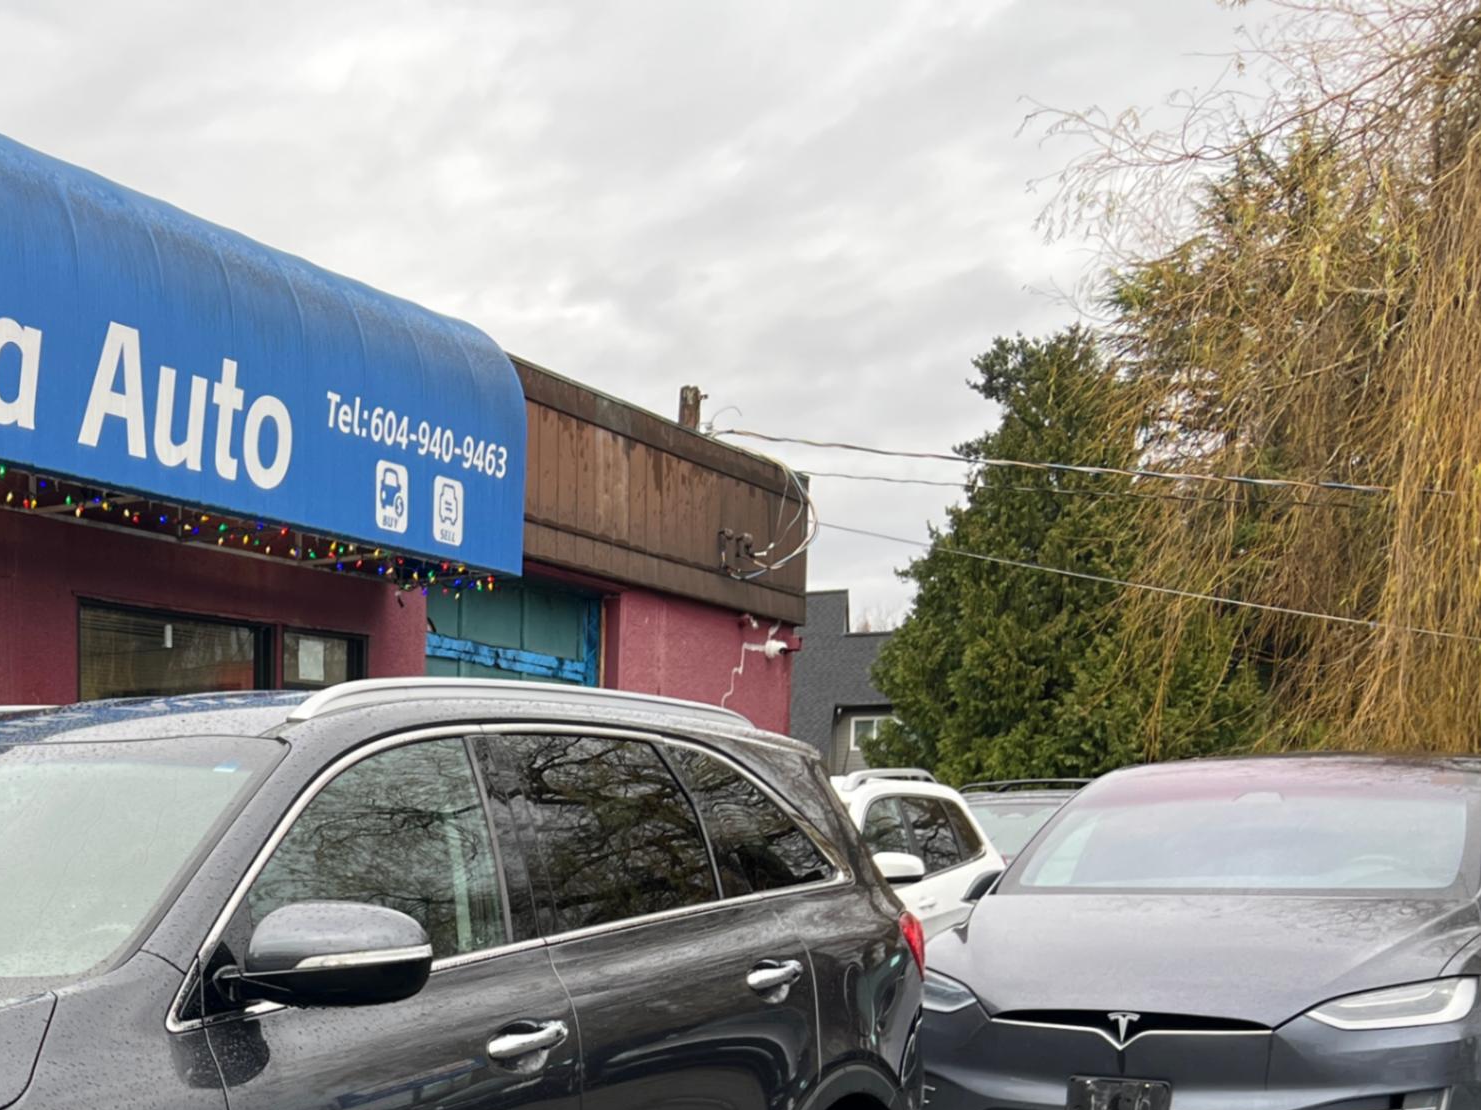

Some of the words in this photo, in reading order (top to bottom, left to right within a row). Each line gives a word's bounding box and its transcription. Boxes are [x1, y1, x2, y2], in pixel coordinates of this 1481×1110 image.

[77, 321, 293, 490] Auto
[382, 514, 399, 529] BUY
[439, 528, 456, 543] SELL
